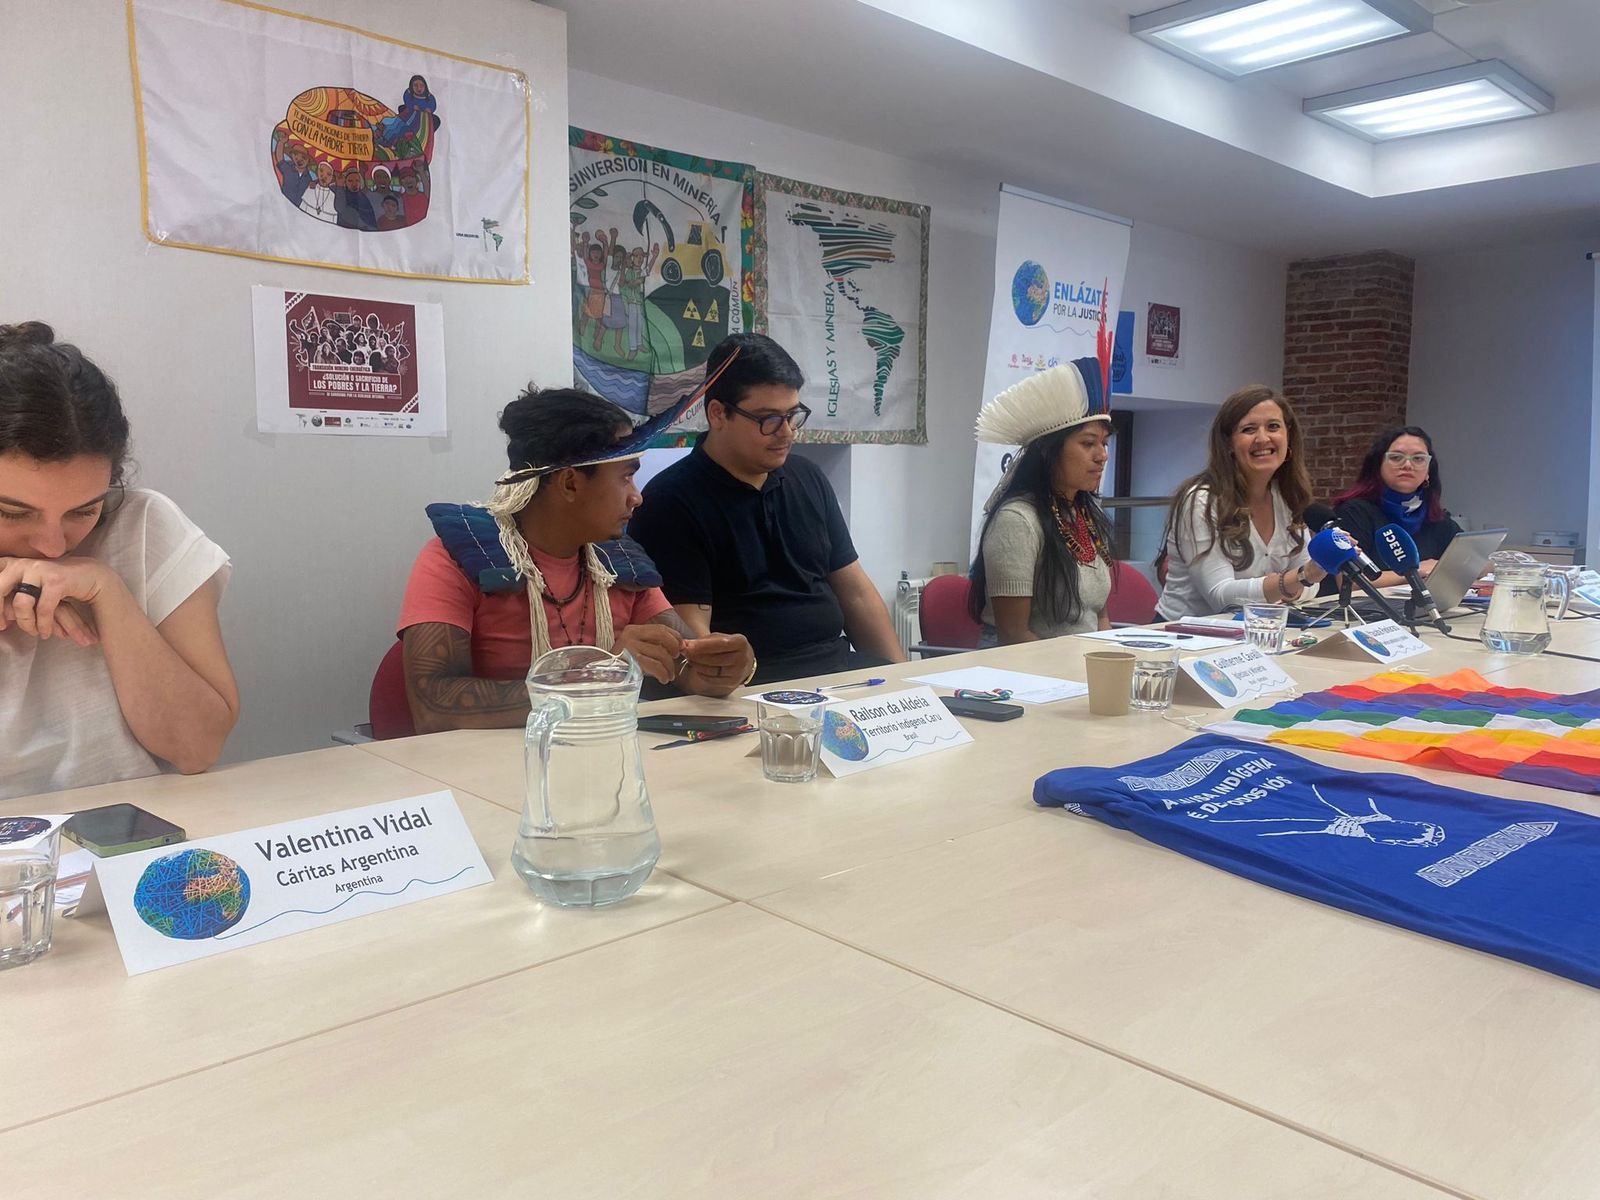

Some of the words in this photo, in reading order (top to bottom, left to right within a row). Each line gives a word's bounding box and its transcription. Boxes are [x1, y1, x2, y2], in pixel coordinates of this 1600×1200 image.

[292, 120, 309, 137] CON
[308, 127, 319, 142] LA
[319, 132, 345, 154] MADRE
[652, 162, 670, 181] EN
[673, 172, 721, 226] MINERÍA
[823, 281, 835, 342] MINERÍA
[1053, 303, 1067, 316] POR
[1067, 306, 1077, 318] LA
[825, 346, 836, 356] Y
[313, 380, 327, 390] LOS
[328, 381, 354, 391] POBRES
[355, 382, 360, 391] Y
[361, 383, 370, 392] LA
[371, 383, 398, 393] TIERRA?
[322, 373, 350, 382] ¿SOLUCIÓN
[355, 375, 381, 383] SACRIFICIO
[826, 359, 840, 417] IGLESIAS
[1382, 529, 1407, 562] TRECE
[849, 705, 888, 722] Railson
[886, 701, 901, 715] da
[899, 695, 930, 712] Aldeia
[862, 722, 899, 738] Territorio
[924, 713, 943, 723] Caru
[1161, 799, 1179, 810] A
[1186, 811, 1209, 820] É
[254, 824, 374, 862] Valentina
[372, 806, 433, 836] Vidal
[276, 862, 336, 887] Cáritas
[341, 844, 420, 873] Argentina
[335, 873, 384, 893] Argentina
